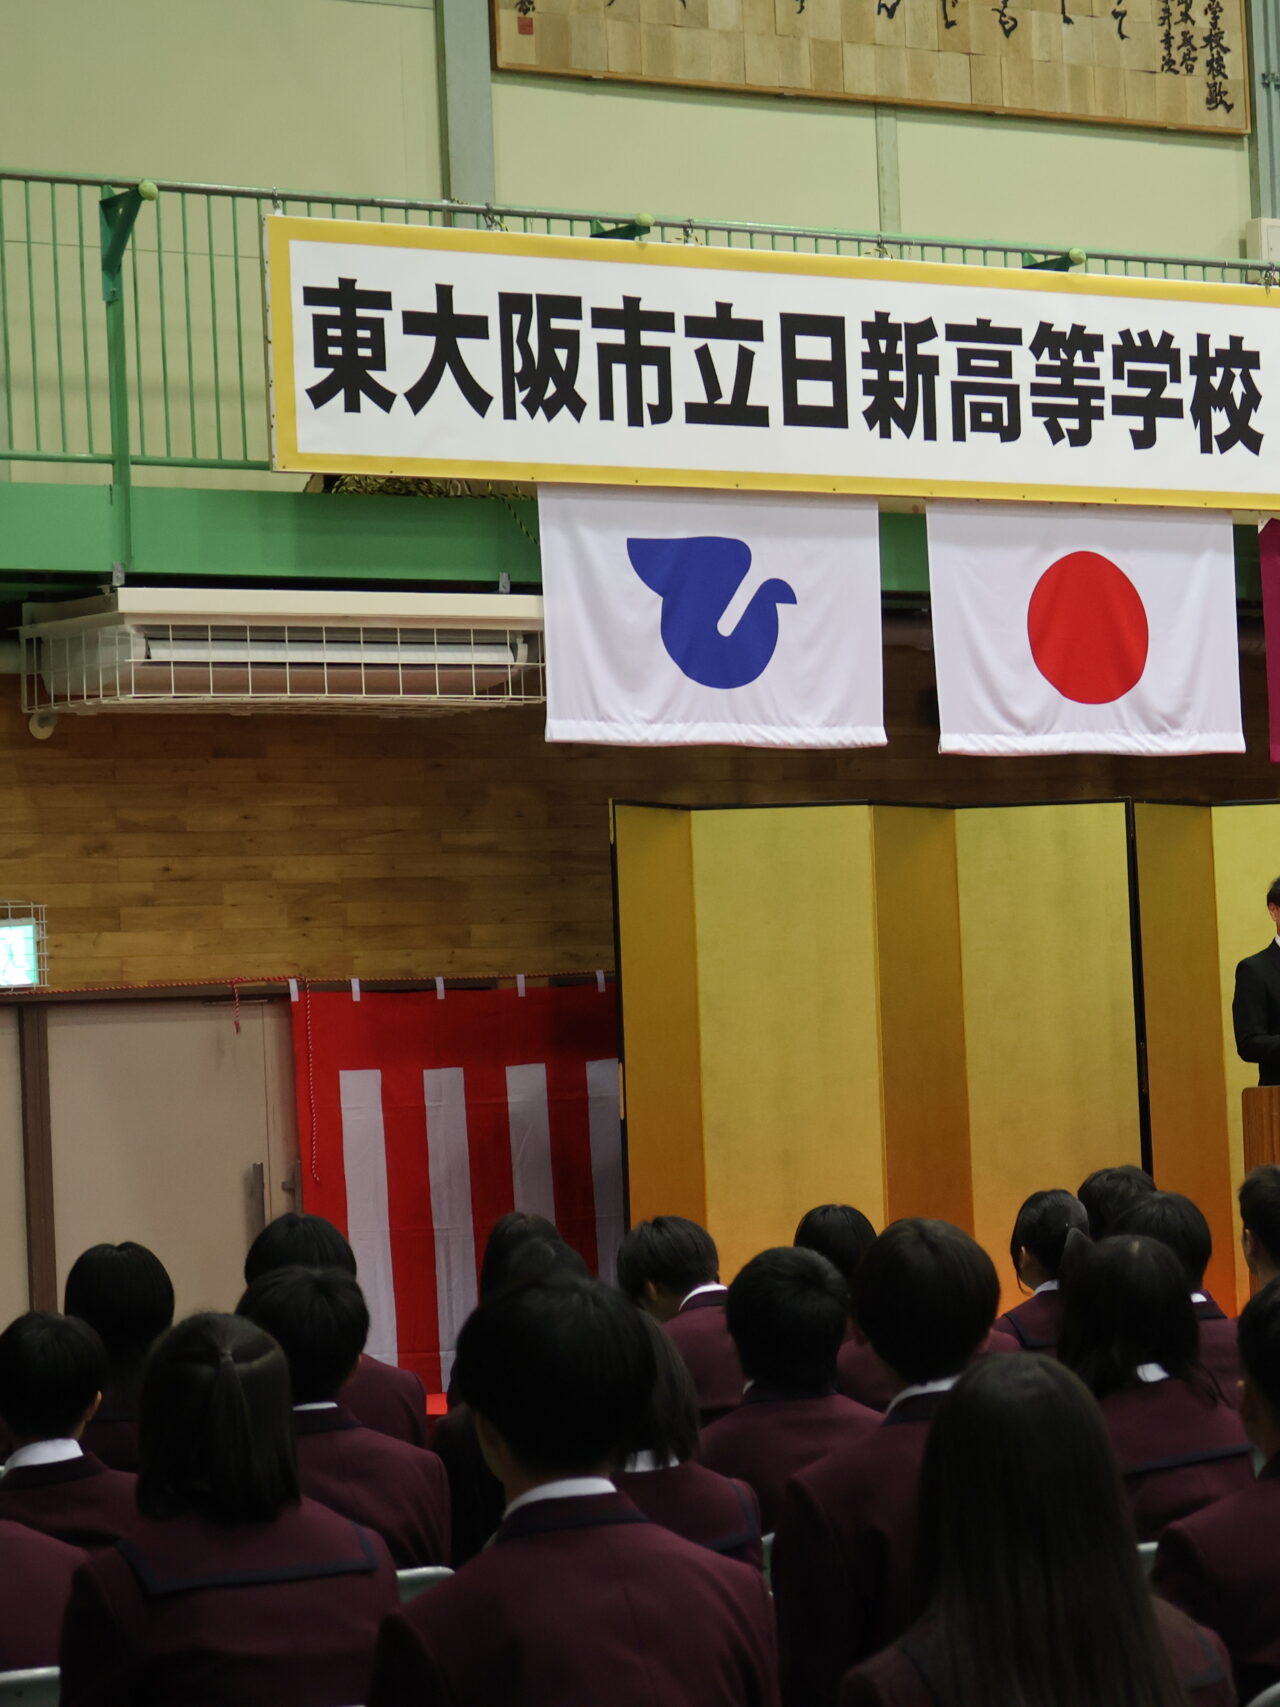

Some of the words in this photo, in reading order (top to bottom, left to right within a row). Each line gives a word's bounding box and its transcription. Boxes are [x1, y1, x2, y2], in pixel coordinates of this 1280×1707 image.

[303, 277, 1264, 456] 東大阪市立日新高等学校
